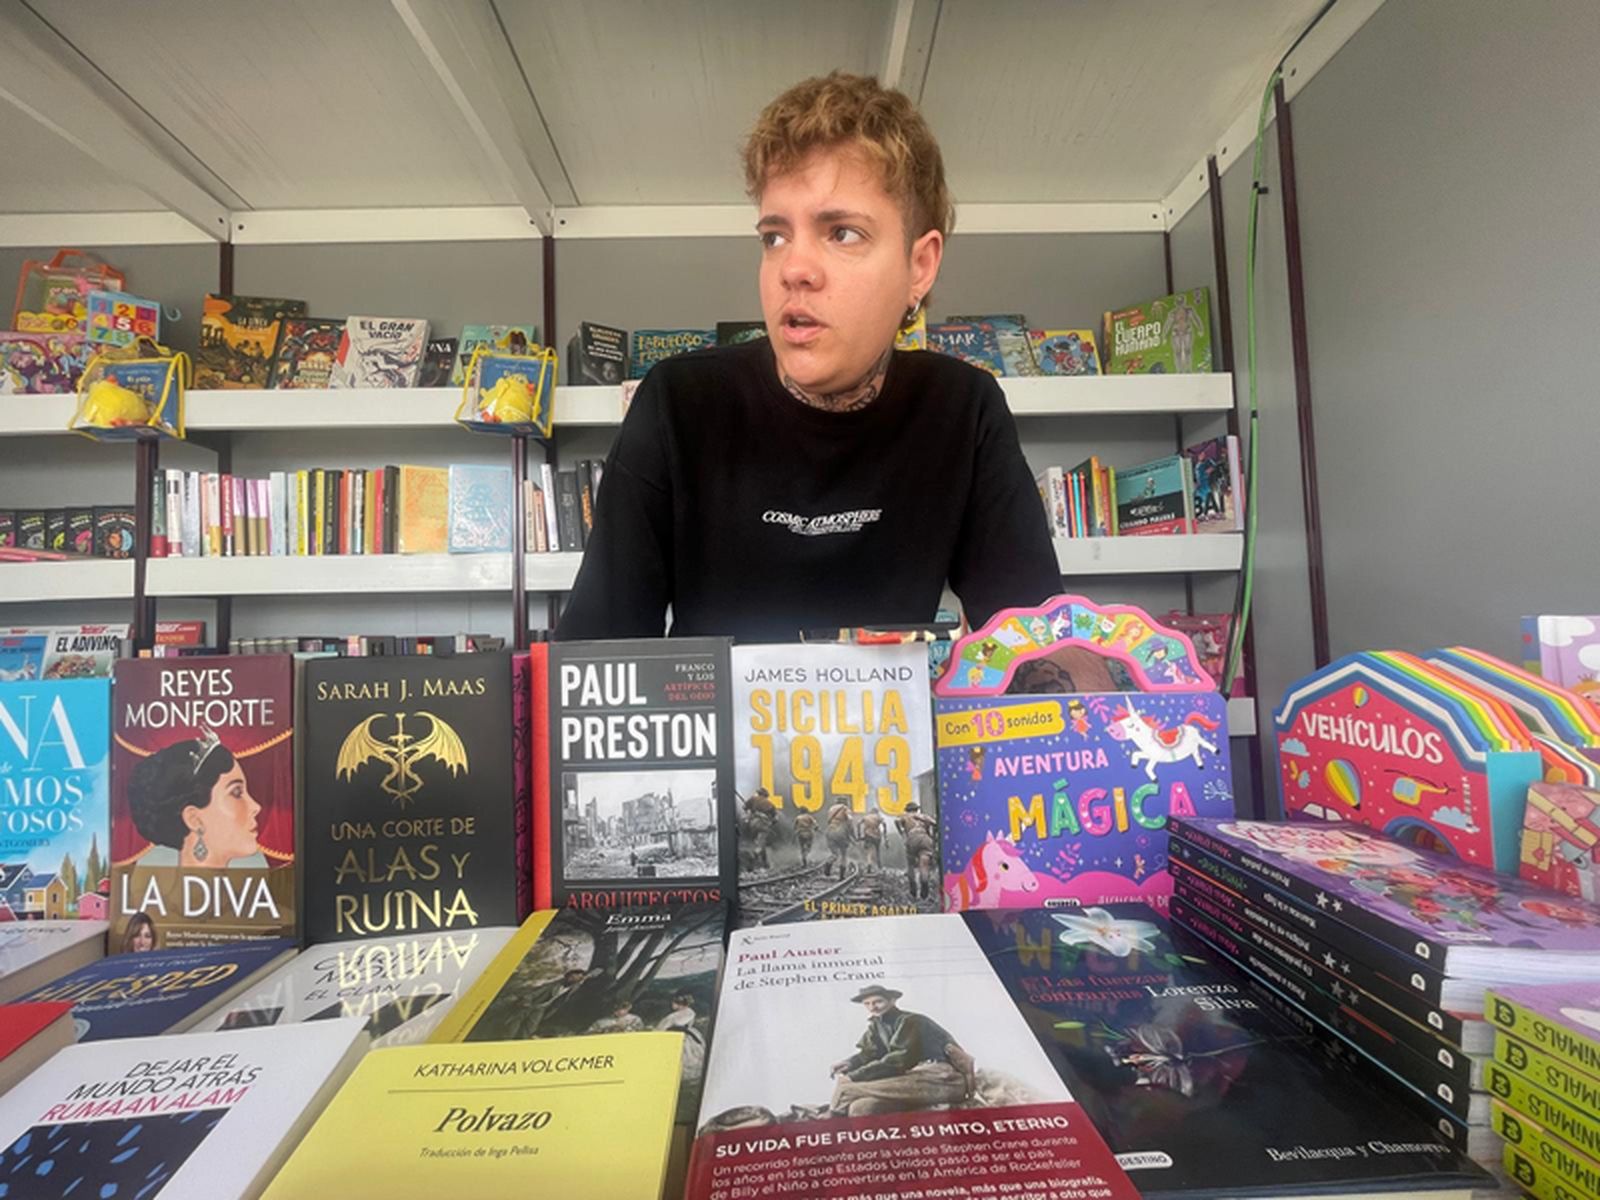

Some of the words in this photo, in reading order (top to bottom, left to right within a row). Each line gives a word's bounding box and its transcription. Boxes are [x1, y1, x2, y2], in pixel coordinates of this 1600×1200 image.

[118, 303, 129, 315] 2
[96, 328, 108, 339] 7
[116, 317, 131, 331] 5
[360, 322, 375, 330] EL
[380, 322, 415, 331] GRAN
[1115, 321, 1161, 344] CUERPO
[762, 510, 808, 526] COSMIC
[56, 637, 68, 652] EL
[70, 635, 118, 651] ADIVINO
[675, 663, 716, 672] FRANCO
[744, 667, 808, 684] JAMES
[816, 666, 913, 684] HOLLAND
[160, 669, 233, 697] REYES
[317, 681, 390, 701] SARAH
[400, 679, 414, 702] J.
[422, 678, 486, 697] MAAS
[561, 663, 647, 707] PAUL
[125, 699, 275, 729] MONFORTE
[750, 688, 909, 735] SICILIA
[945, 722, 970, 736] Con
[971, 710, 1006, 738] 10
[1006, 712, 1053, 728] sonidos
[561, 712, 717, 761] PRESTON
[1301, 710, 1444, 764] VEHÍCULOS
[750, 733, 913, 816] 1943
[994, 748, 1110, 778] AVENTURA
[1007, 778, 1197, 842] MÁGICA
[330, 822, 376, 841] UNA
[382, 818, 445, 839] CORTE
[451, 817, 476, 836] DE
[334, 844, 442, 885] ALAS
[451, 852, 472, 879] Y
[121, 875, 167, 917] LA
[183, 875, 280, 919] DIVA
[567, 888, 721, 912] ARQUITECTOS
[804, 900, 818, 913] EL
[821, 900, 868, 917] PRIMER
[335, 888, 479, 935] RUINA
[605, 913, 672, 926] Emma
[736, 966, 757, 977] La
[761, 962, 806, 974] llama
[811, 956, 884, 970] inmortal
[738, 952, 777, 963] Paul
[782, 947, 842, 958] Auster
[734, 979, 756, 992] de
[759, 972, 828, 989] Stephen
[832, 970, 886, 982] Crane
[1088, 974, 1170, 987] fuerzas
[1144, 984, 1239, 998] Lorenzo
[1194, 995, 1259, 1012] Silva
[126, 1057, 210, 1078] DEJAR
[210, 1054, 238, 1070] EL
[413, 1062, 518, 1078] KATHARINA
[520, 1055, 615, 1074] VOLCKMER
[66, 1077, 176, 1101] MUNDO
[174, 1065, 264, 1092] ATRÁS
[40, 1095, 169, 1122] RUMAAN
[163, 1086, 250, 1111] ALAM
[433, 1106, 552, 1133] Polvazo
[716, 1144, 741, 1158] SU
[745, 1137, 791, 1154] VIDA
[796, 1132, 832, 1148] FUE
[837, 1126, 907, 1145] FUGAZ.
[910, 1124, 934, 1139] SU
[938, 1120, 992, 1138] MITO,
[994, 1116, 1070, 1134] ETERNO
[420, 1147, 472, 1158] Traducción
[473, 1148, 488, 1157] de
[713, 1166, 731, 1177] Un
[733, 1158, 790, 1173] recorrido
[792, 1152, 854, 1167] fascinante
[857, 1150, 878, 1162] por
[880, 1146, 892, 1157] la
[894, 1144, 920, 1156] vida
[922, 1145, 938, 1156] de
[939, 1140, 991, 1155] Stephen
[992, 1138, 1029, 1151] Crane
[1030, 1136, 1078, 1148] durante
[1266, 1144, 1352, 1162] Bevilacqua
[1358, 1144, 1366, 1157] y
[1366, 1140, 1450, 1155] Chamorro
[710, 1190, 728, 1200] de
[731, 1186, 760, 1199] Billy
[762, 1183, 775, 1195] el
[776, 1179, 808, 1192] Niño
[810, 1180, 820, 1188] a
[822, 1172, 896, 1187] convertirse
[898, 1171, 916, 1180] en
[916, 1168, 930, 1180] la
[932, 1163, 988, 1178] América
[989, 1162, 1008, 1173] de
[1009, 1158, 1082, 1172] Rockefeller
[711, 1178, 730, 1189] los
[733, 1172, 764, 1186] años
[767, 1172, 784, 1180] en
[786, 1169, 806, 1179] los
[808, 1166, 834, 1178] que
[836, 1161, 888, 1173] Estados
[890, 1156, 936, 1169] Unidos
[938, 1153, 970, 1167] pasó
[972, 1152, 990, 1162] de
[991, 1151, 1010, 1161] ser
[1012, 1150, 1026, 1160] el
[1028, 1148, 1054, 1161] país
[900, 1190, 924, 1199] una
[926, 1186, 970, 1197] novela,
[972, 1182, 997, 1192] más
[998, 1181, 1023, 1192] que
[1024, 1180, 1048, 1189] una
